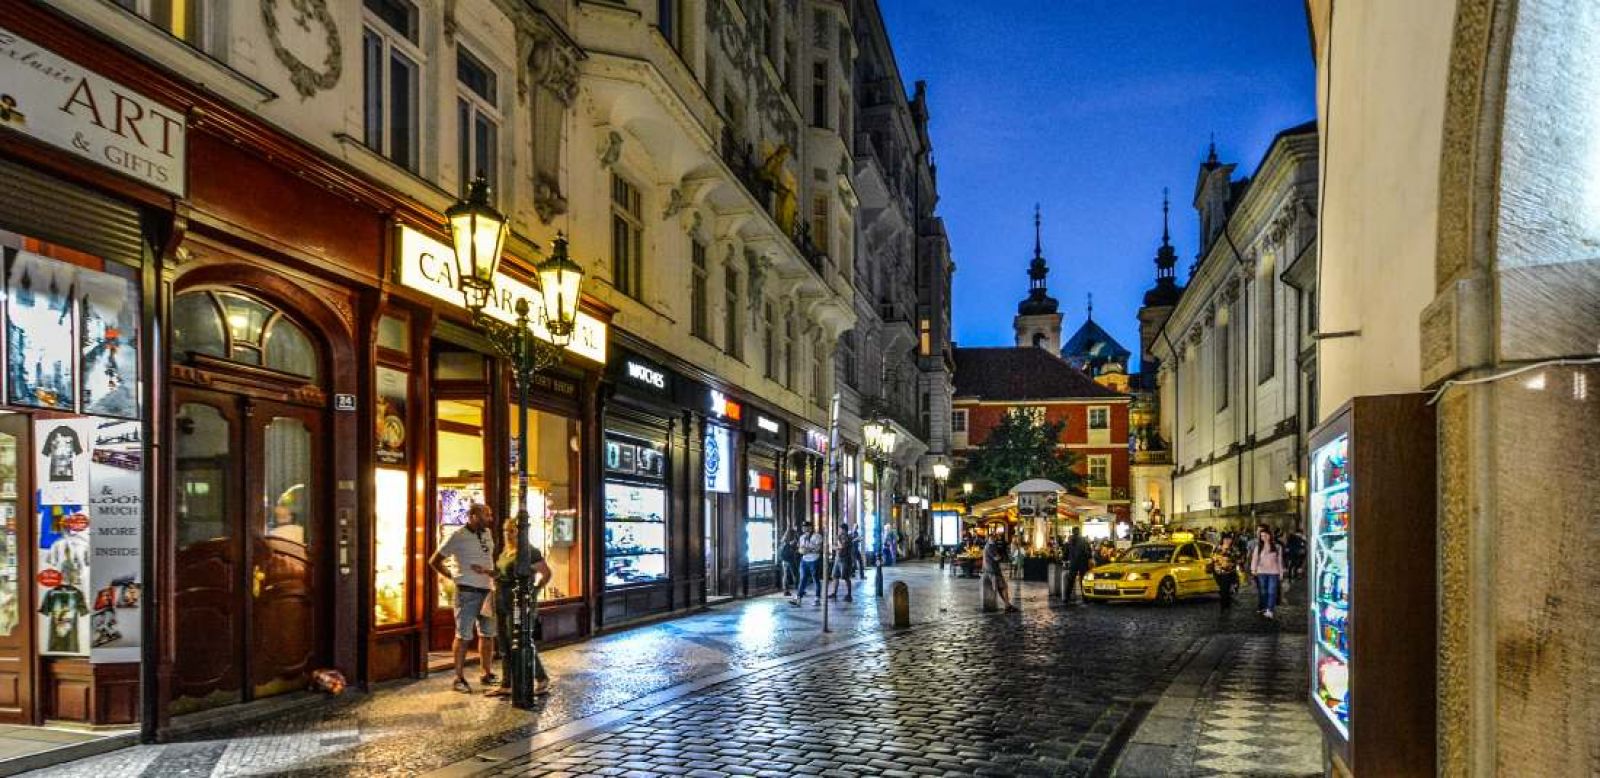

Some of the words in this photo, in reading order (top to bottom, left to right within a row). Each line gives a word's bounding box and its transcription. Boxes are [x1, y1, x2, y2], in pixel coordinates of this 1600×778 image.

[58, 76, 183, 159] ART
[72, 131, 90, 151] &
[104, 145, 169, 183] GIFTS
[98, 506, 138, 516] MUCH
[98, 527, 137, 536] MORE
[95, 547, 139, 557] INSIDE
